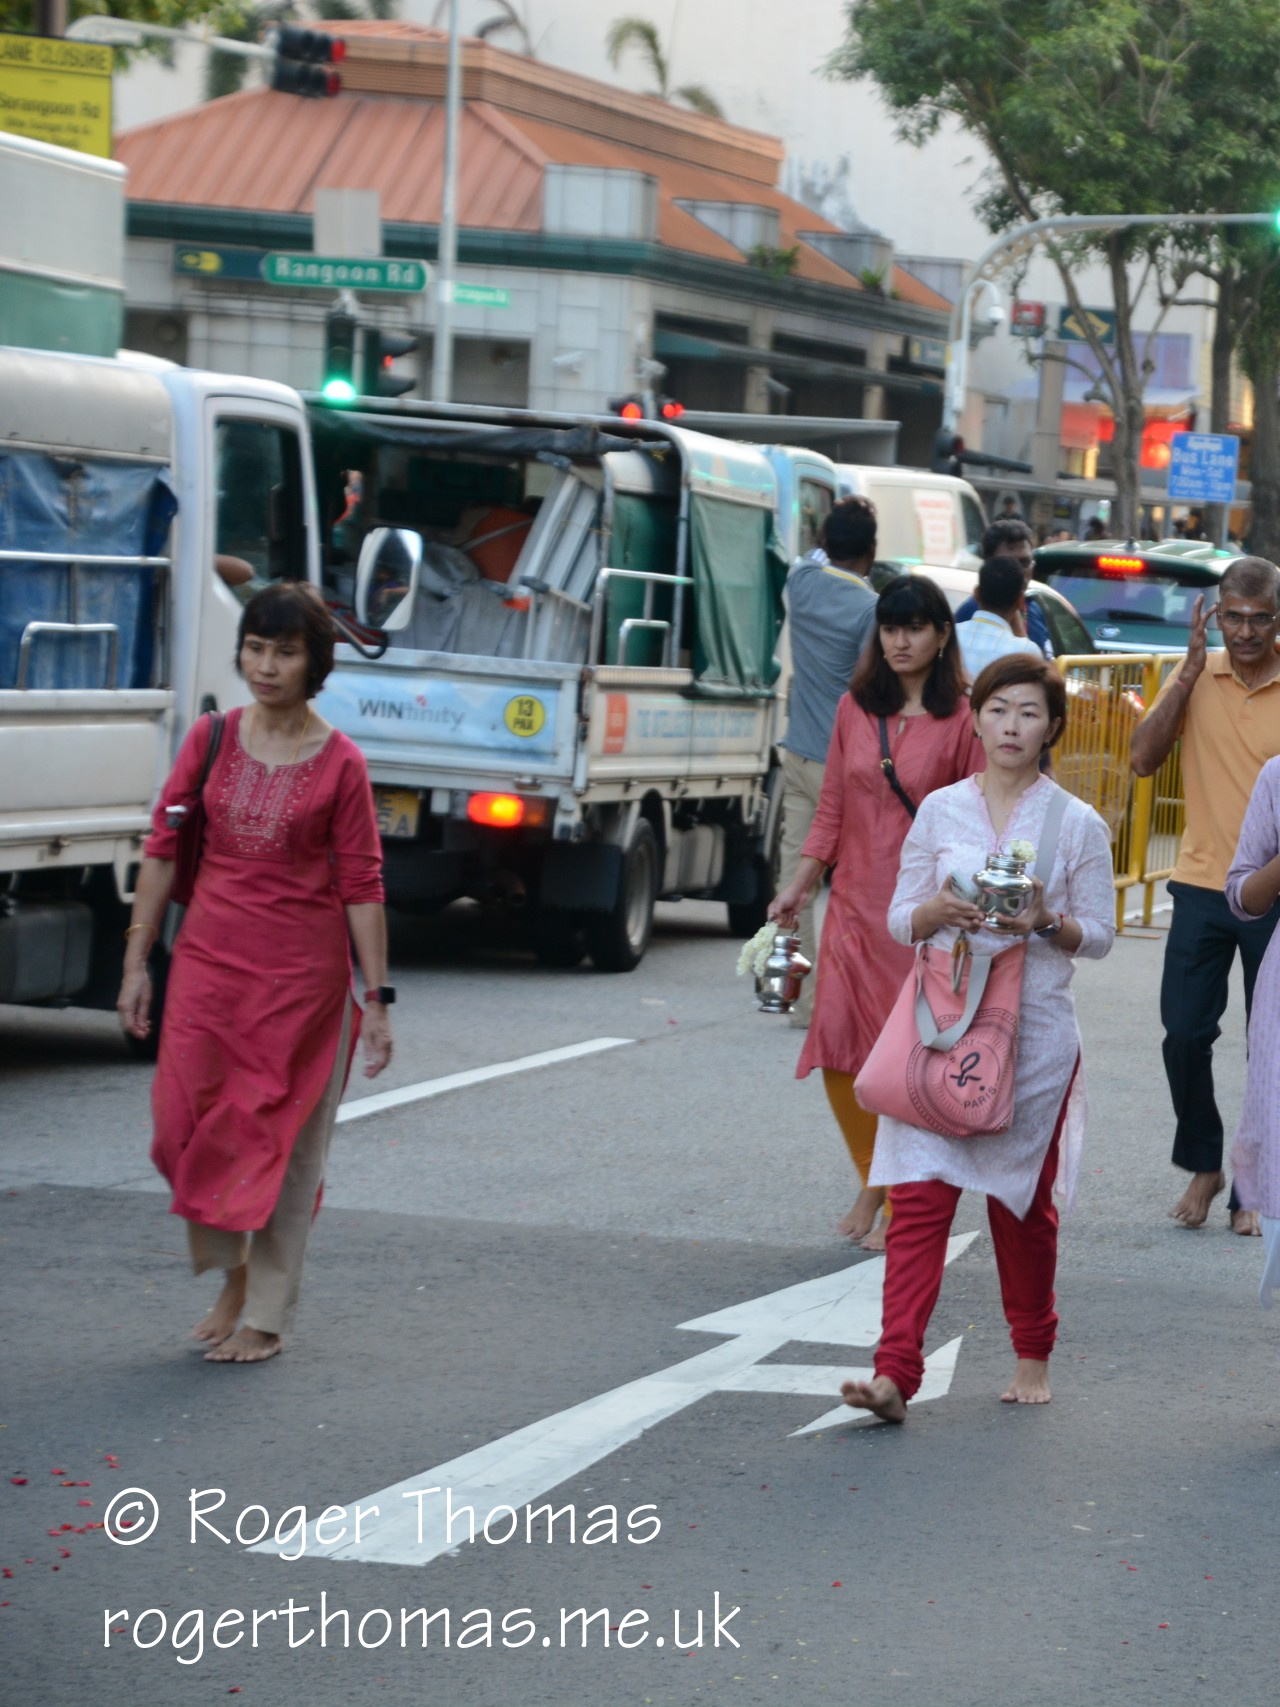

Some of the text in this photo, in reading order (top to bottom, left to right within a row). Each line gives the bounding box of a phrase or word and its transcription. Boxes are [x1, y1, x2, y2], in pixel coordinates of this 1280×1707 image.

[0, 39, 32, 61] ANE
[274, 256, 418, 285] Rangoon Rd
[1172, 446, 1234, 468] Bus Lane
[516, 698, 534, 717] 13
[949, 1038, 976, 1064] SORT
[963, 1086, 998, 1110] PARIS
